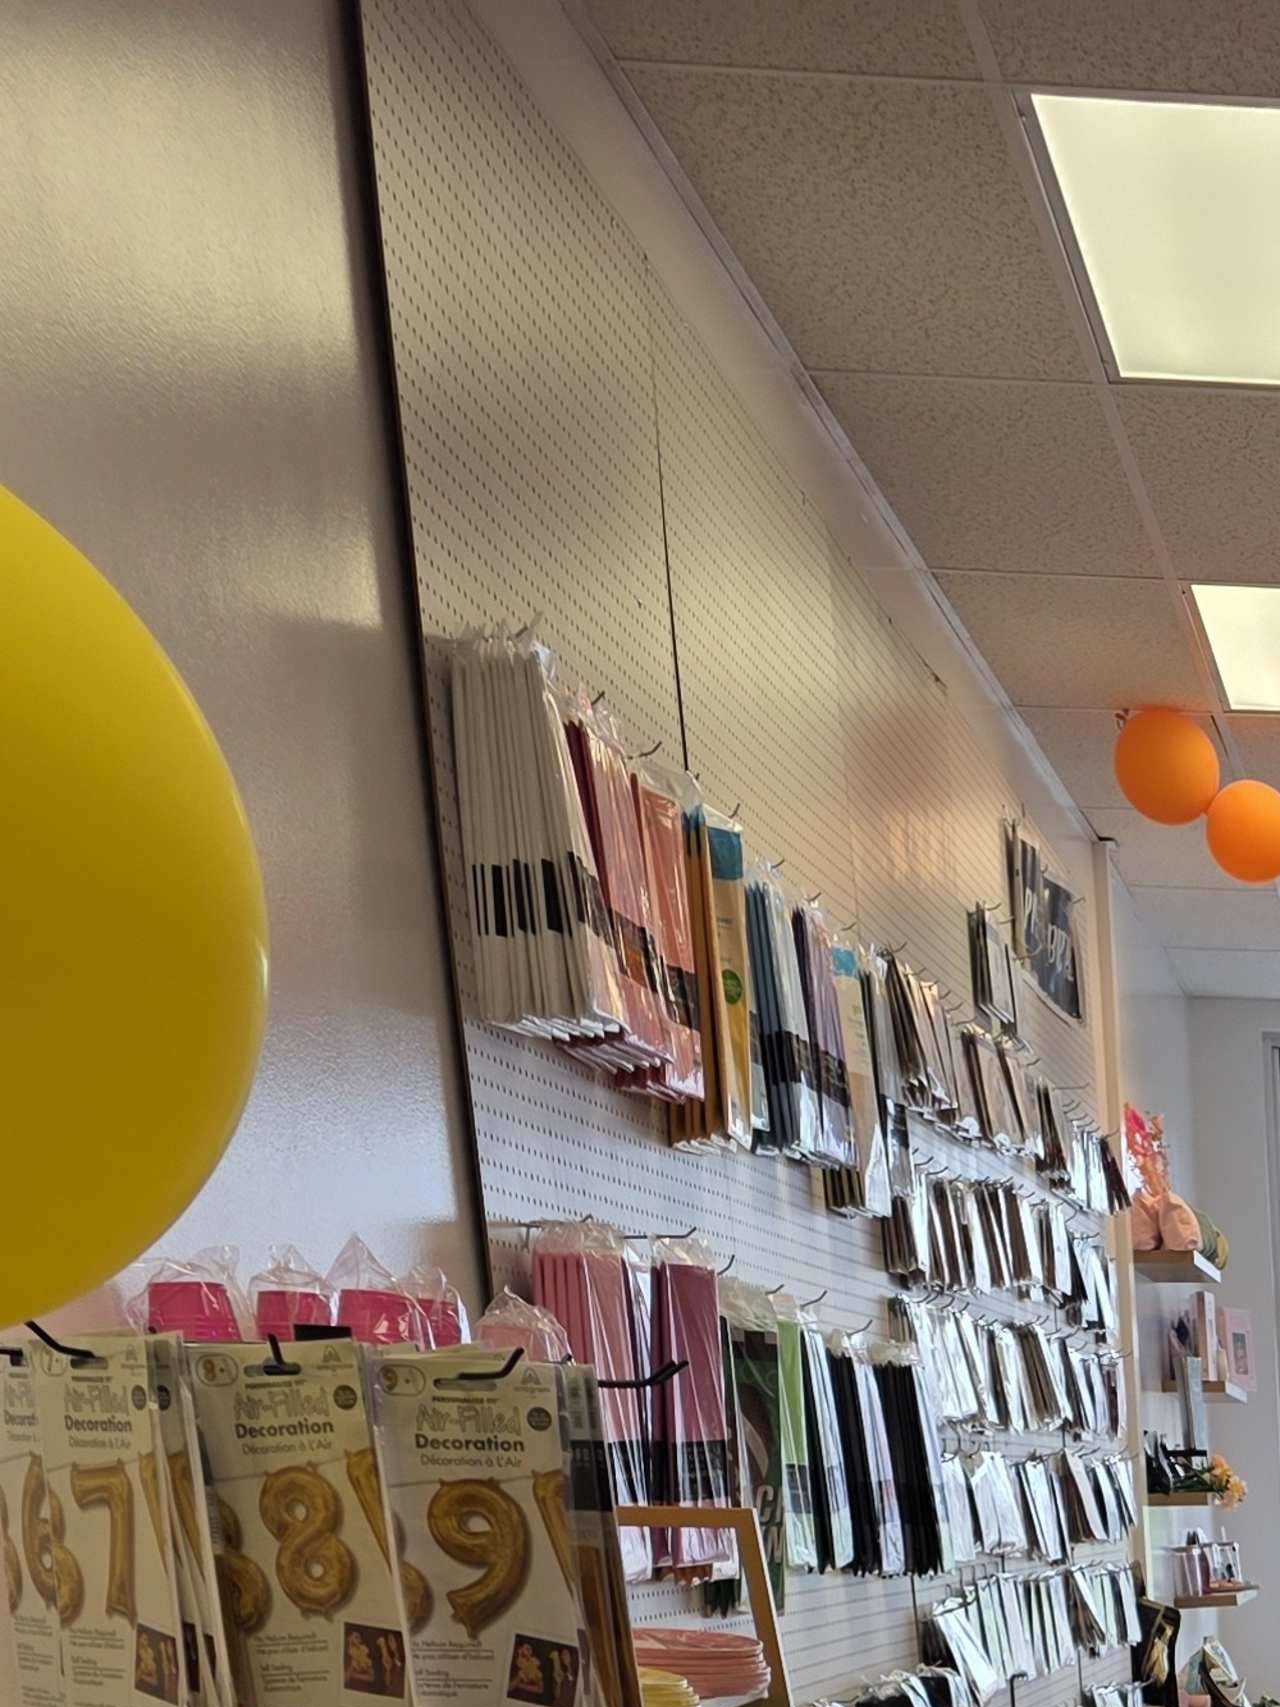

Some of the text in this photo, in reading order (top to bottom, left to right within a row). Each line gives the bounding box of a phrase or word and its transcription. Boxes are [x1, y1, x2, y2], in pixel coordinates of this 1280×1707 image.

[64, 1414, 133, 1433] Decoration
[235, 1418, 334, 1439] Decoration
[415, 1433, 525, 1452] Decoration
